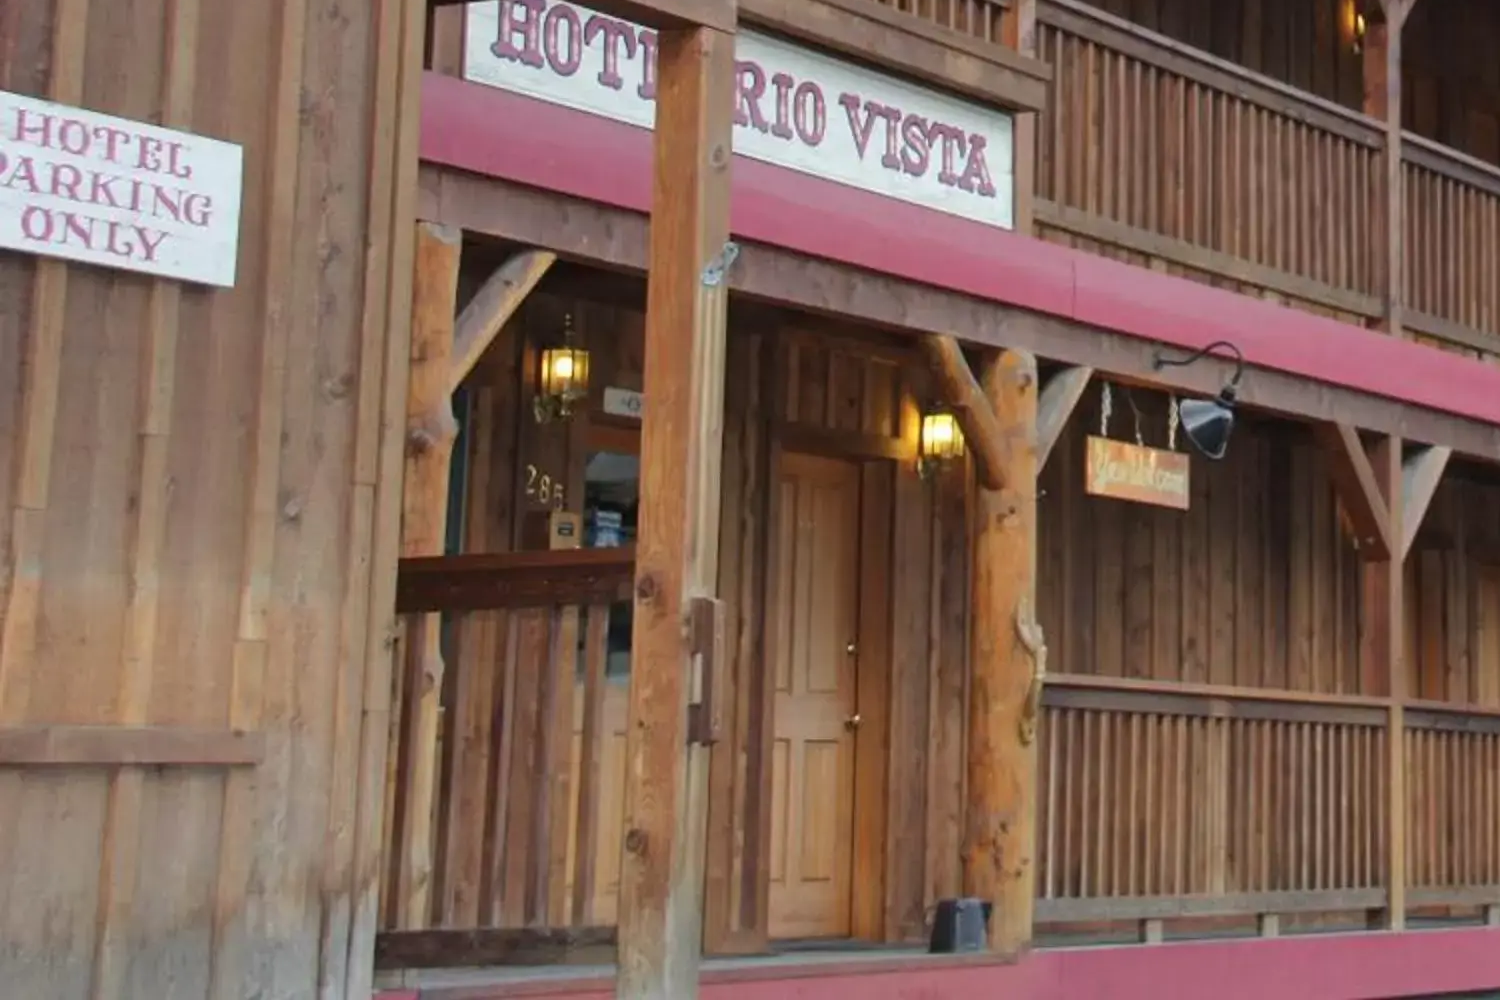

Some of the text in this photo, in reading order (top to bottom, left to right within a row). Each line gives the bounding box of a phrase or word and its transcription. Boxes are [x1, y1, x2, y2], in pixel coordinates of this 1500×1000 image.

[8, 106, 193, 179] HOTEL
[732, 60, 826, 147] RIO
[838, 92, 996, 198] VISTA
[20, 204, 169, 263] ONLY
